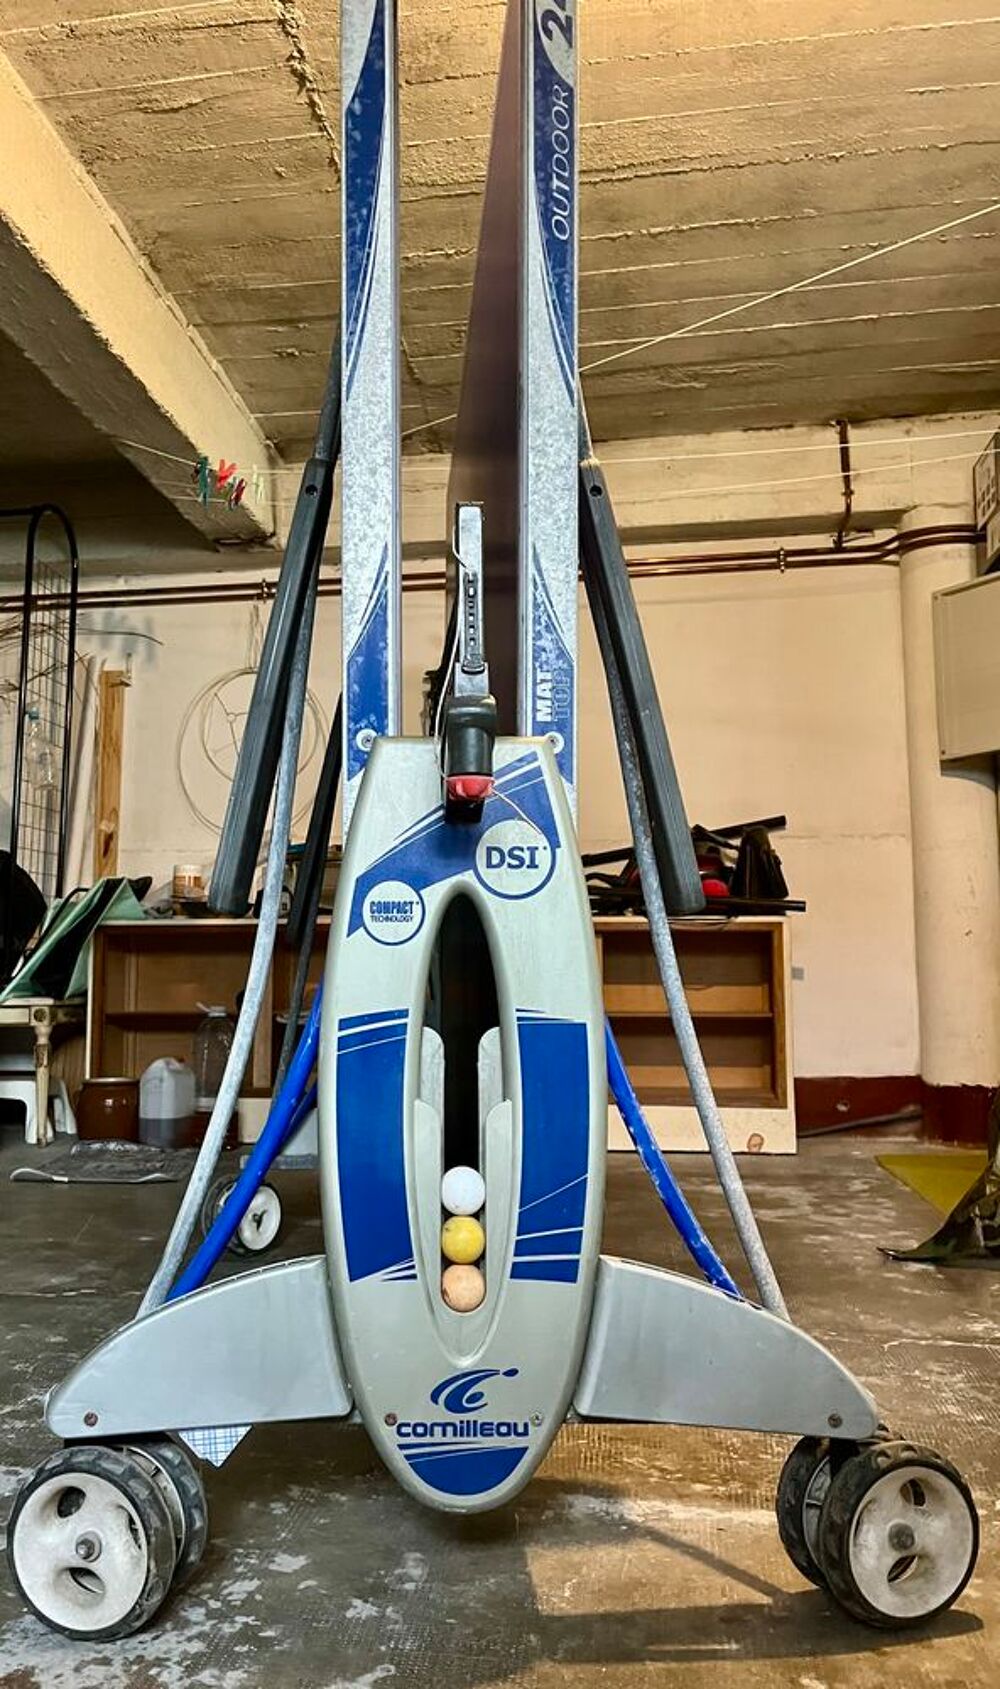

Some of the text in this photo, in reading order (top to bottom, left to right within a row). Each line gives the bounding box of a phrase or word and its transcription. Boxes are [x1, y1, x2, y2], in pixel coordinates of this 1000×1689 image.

[551, 84, 570, 241] OUTDOOR
[536, 669, 553, 722] MAT
[485, 846, 539, 869] DSI
[369, 901, 413, 914] COMPACT
[370, 915, 413, 923] TECHNOLOGY
